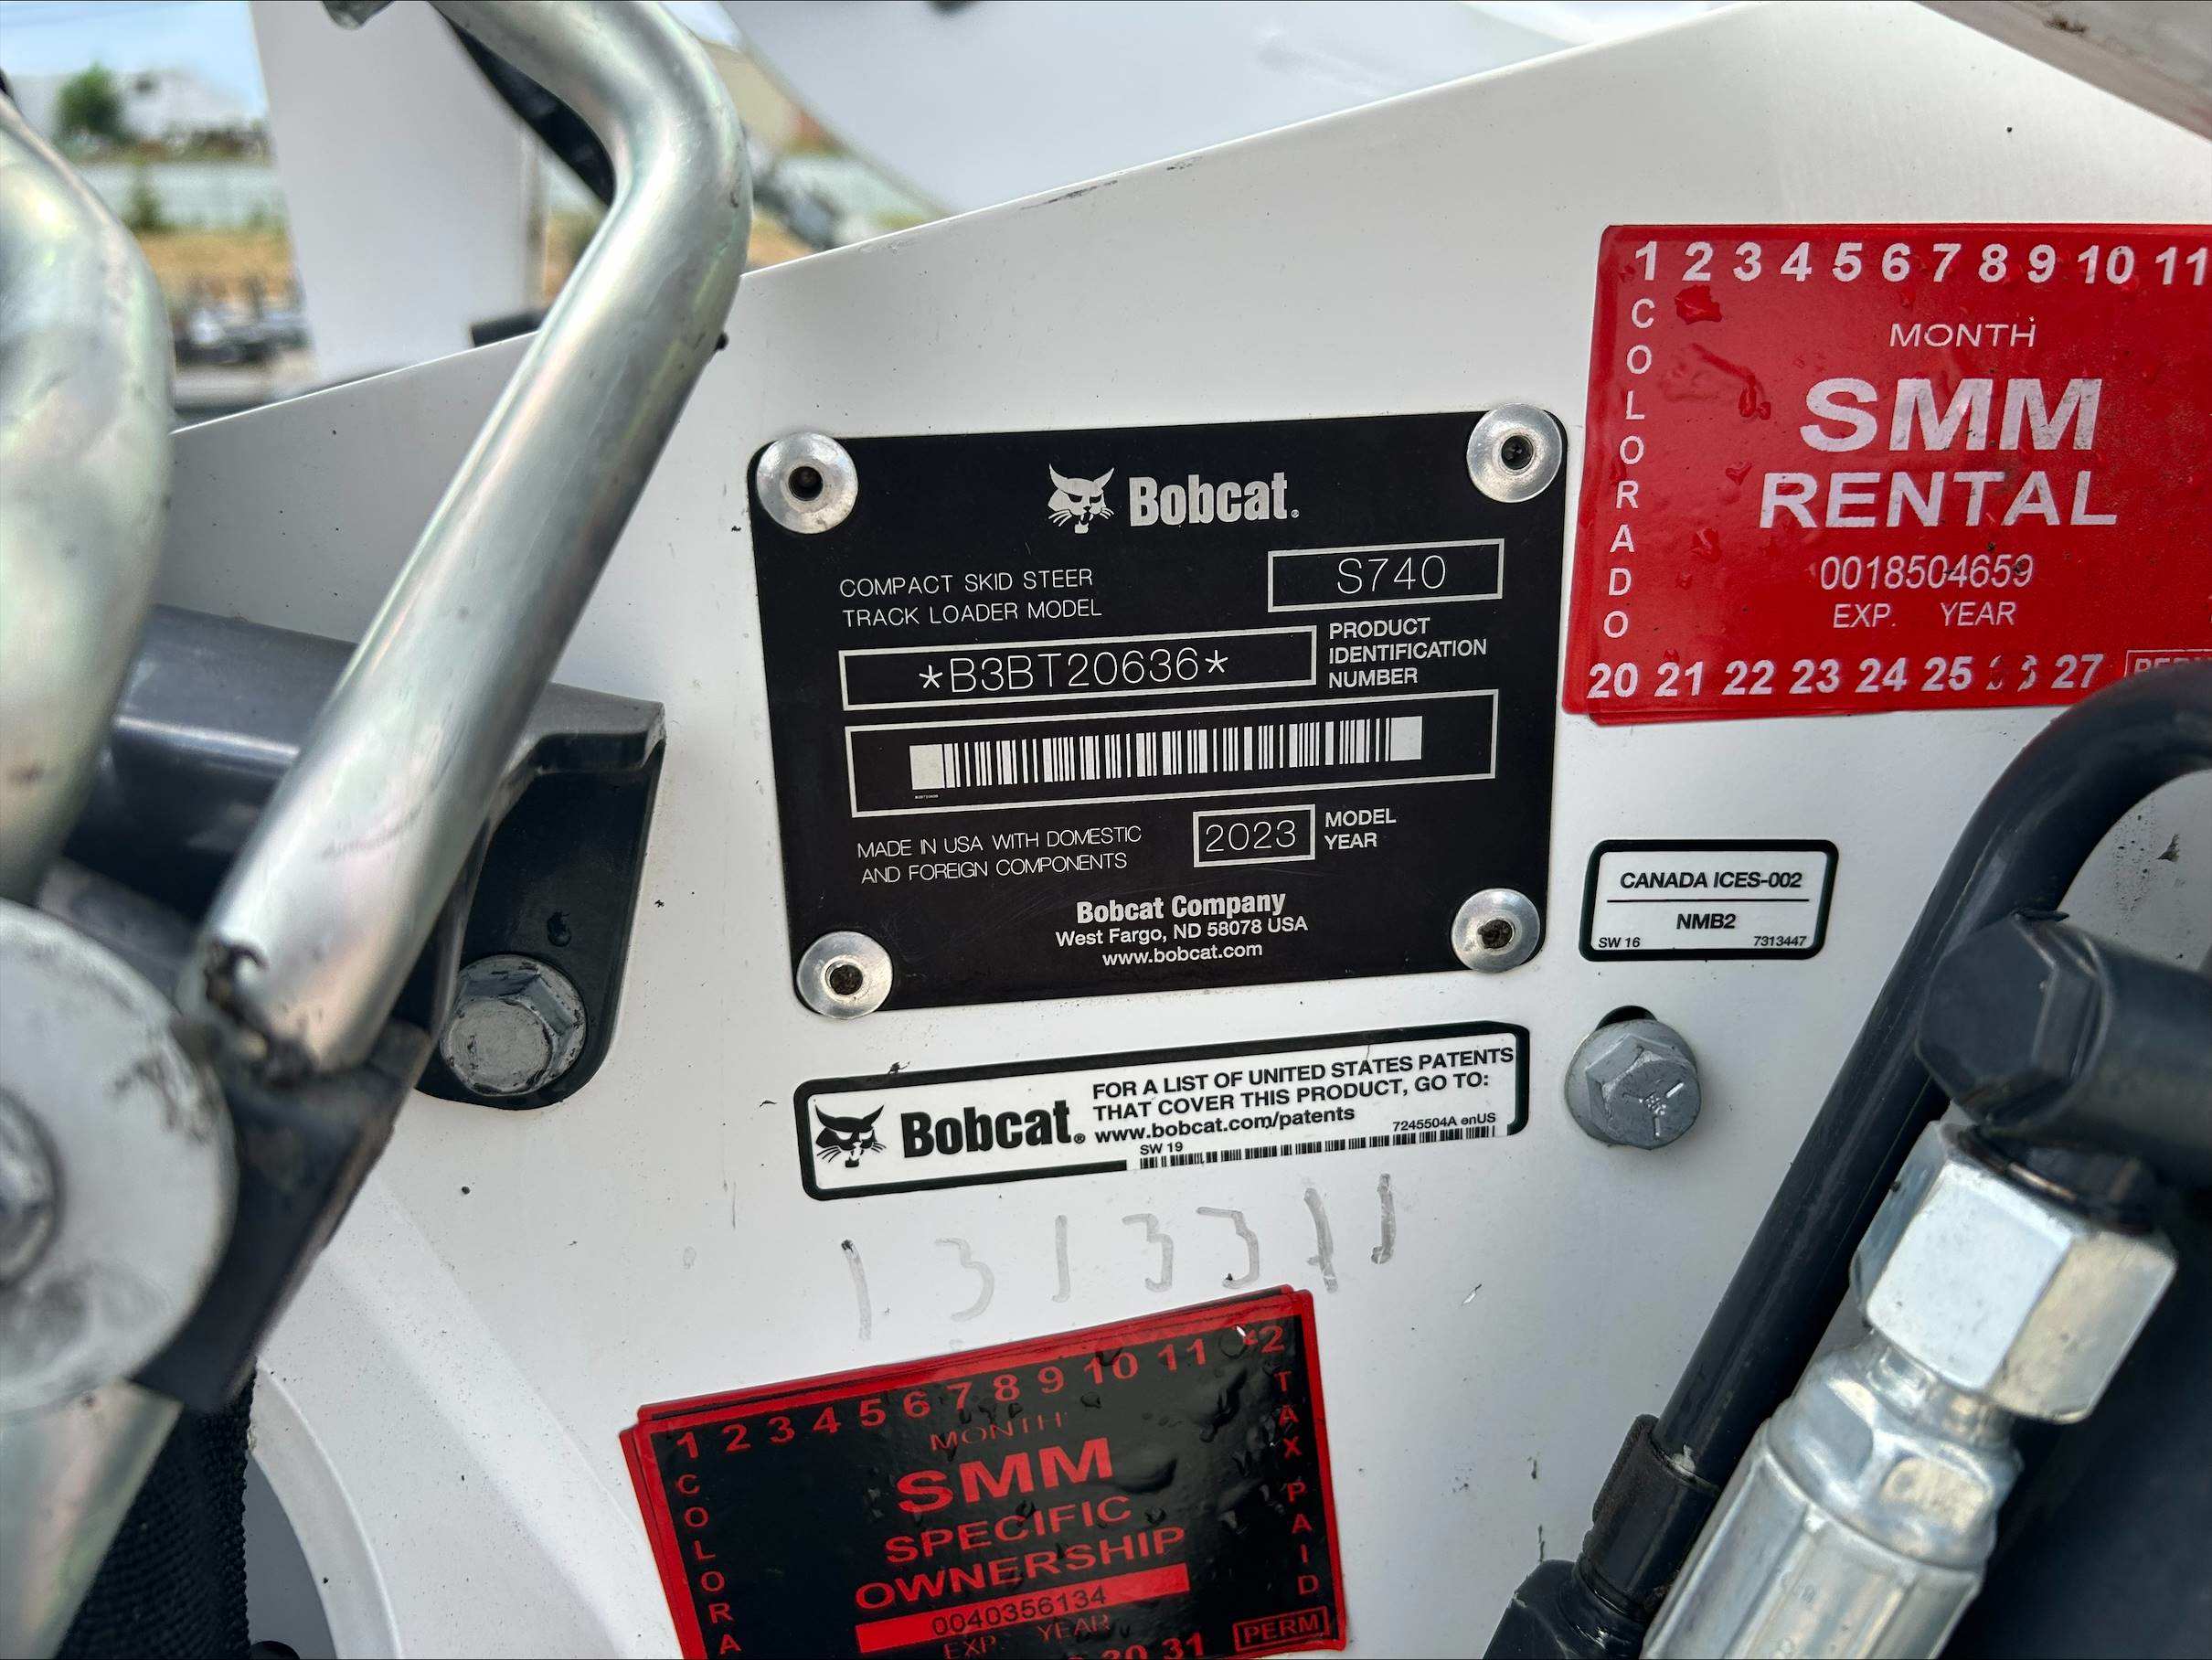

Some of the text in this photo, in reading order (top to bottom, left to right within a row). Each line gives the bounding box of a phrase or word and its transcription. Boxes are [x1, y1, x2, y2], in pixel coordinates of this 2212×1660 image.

[1634, 241, 2209, 286] 1 2 3 4 5 6 7 8 9 10 11
[1889, 323, 2037, 347] MONTH
[1799, 378, 2102, 452] SMM
[1759, 470, 2118, 528] RENTAL
[839, 568, 1093, 598] COMPACT SKID STEER
[1336, 555, 1446, 595] S740
[1820, 554, 2035, 591] 0018504659
[842, 599, 1102, 628] TRACK LOADER MODEL
[1328, 617, 1430, 640] PRODUCT
[1941, 601, 2016, 626] YEAR
[1328, 638, 1487, 665] IDENTIFICATION
[1328, 667, 1418, 688] NUMBER
[1586, 662, 1639, 698] 20
[1654, 661, 1704, 697] 21
[1721, 660, 1775, 696] 22
[1789, 658, 1840, 695] 23
[1855, 657, 1908, 693] 24
[1921, 655, 1973, 692] 25
[2051, 654, 2105, 689] 27
[1324, 807, 1397, 828] MODEL
[856, 825, 1142, 858] MADE IN USA WITH DOMESTIC
[1206, 819, 1296, 853] 2023
[1324, 831, 1377, 850] YEAR
[861, 852, 1127, 885] AND FOREIGN COMPONENTS
[1620, 872, 1802, 889] CANADA ICES-002
[1077, 892, 1287, 924] Bobcat Company
[1675, 913, 1737, 930] NMB2
[1056, 915, 1309, 947] West Fargo, ND 58078 USA
[1598, 937, 1641, 949] SW 16
[1753, 935, 1807, 947] 7313447
[1102, 942, 1263, 967] www.bobcat.com
[1092, 1047, 1514, 1100] FOR A LIST OF UNITED STATES PATENTS
[1093, 1071, 1489, 1122] THAT COVER THIS PRODUCT, GO TO:
[1094, 1106, 1356, 1144] www.bobcat.com/patents
[1392, 1112, 1496, 1133] 7245504A enUS
[1140, 1142, 1184, 1156] SW 19
[676, 1431, 700, 1459] 1
[722, 1424, 751, 1453] 2
[767, 1416, 795, 1443] 3
[812, 1406, 841, 1434] 4
[858, 1398, 887, 1427] 5
[902, 1390, 931, 1418] 6
[946, 1381, 973, 1410] 7
[993, 1374, 1021, 1402] 8
[1037, 1366, 1065, 1394] 9
[1083, 1351, 1139, 1385] 10
[1157, 1338, 1207, 1372] 11
[896, 1437, 1113, 1514] SMM
[885, 1495, 1133, 1564] SPECIFIC
[855, 1526, 1185, 1610] OWNERSHIP
[932, 1585, 1107, 1636] 0040356134
[1038, 1613, 1111, 1644] YEAR
[1244, 1612, 1319, 1645] PERM
